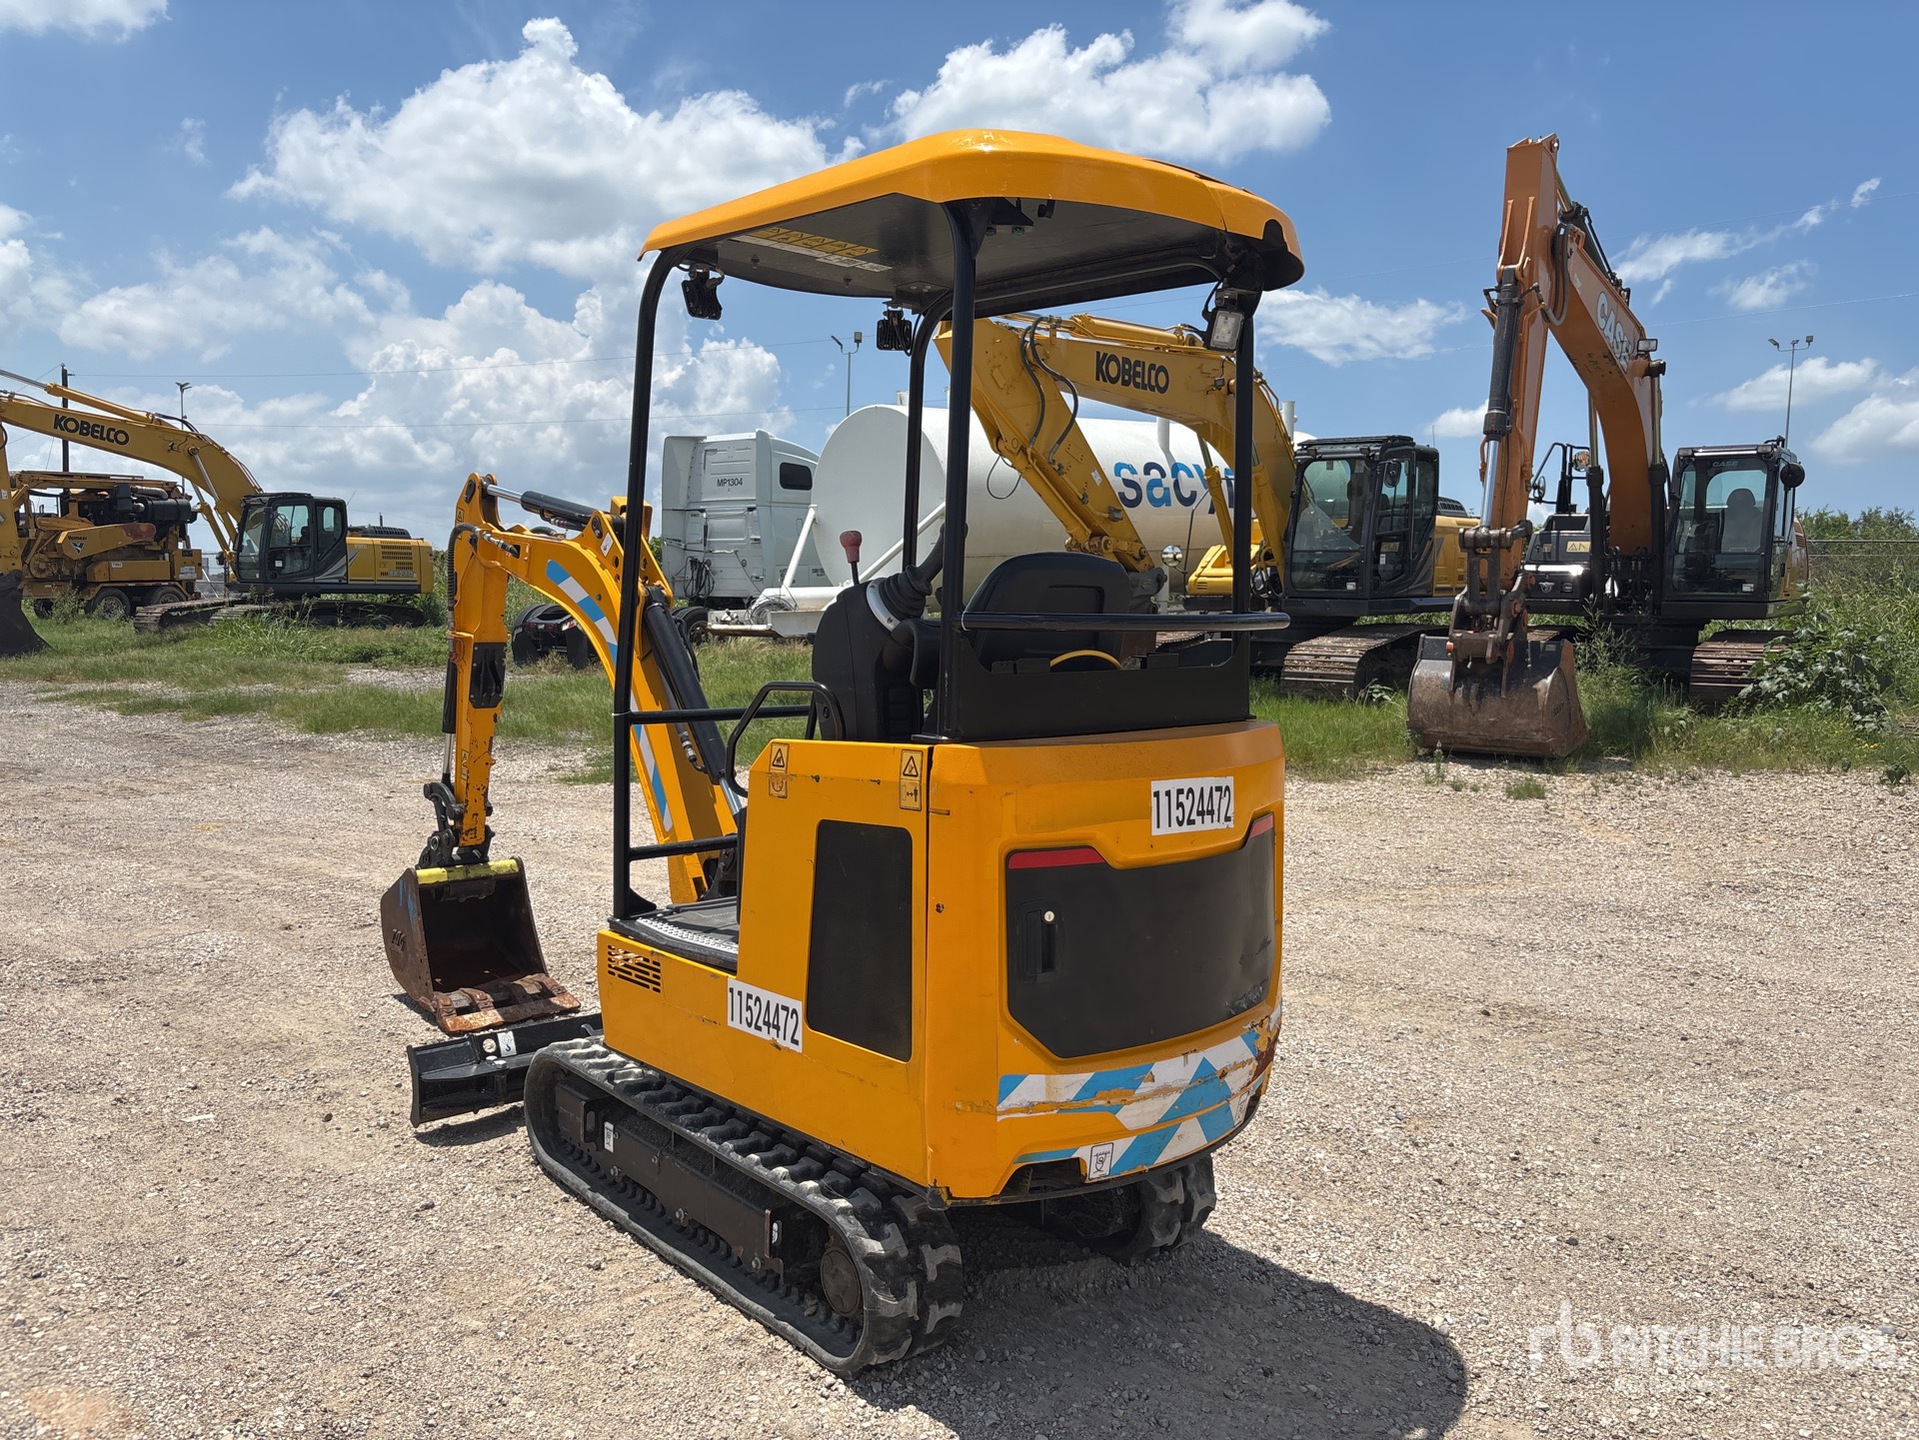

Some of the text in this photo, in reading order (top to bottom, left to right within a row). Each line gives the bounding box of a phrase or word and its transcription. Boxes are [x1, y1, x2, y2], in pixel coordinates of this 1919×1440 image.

[1096, 351, 1169, 394] KOBELCO
[53, 414, 129, 445] KOBELCO
[717, 478, 743, 487] MP1304
[1153, 785, 1231, 829] 11524472
[729, 987, 799, 1046] 11524472
